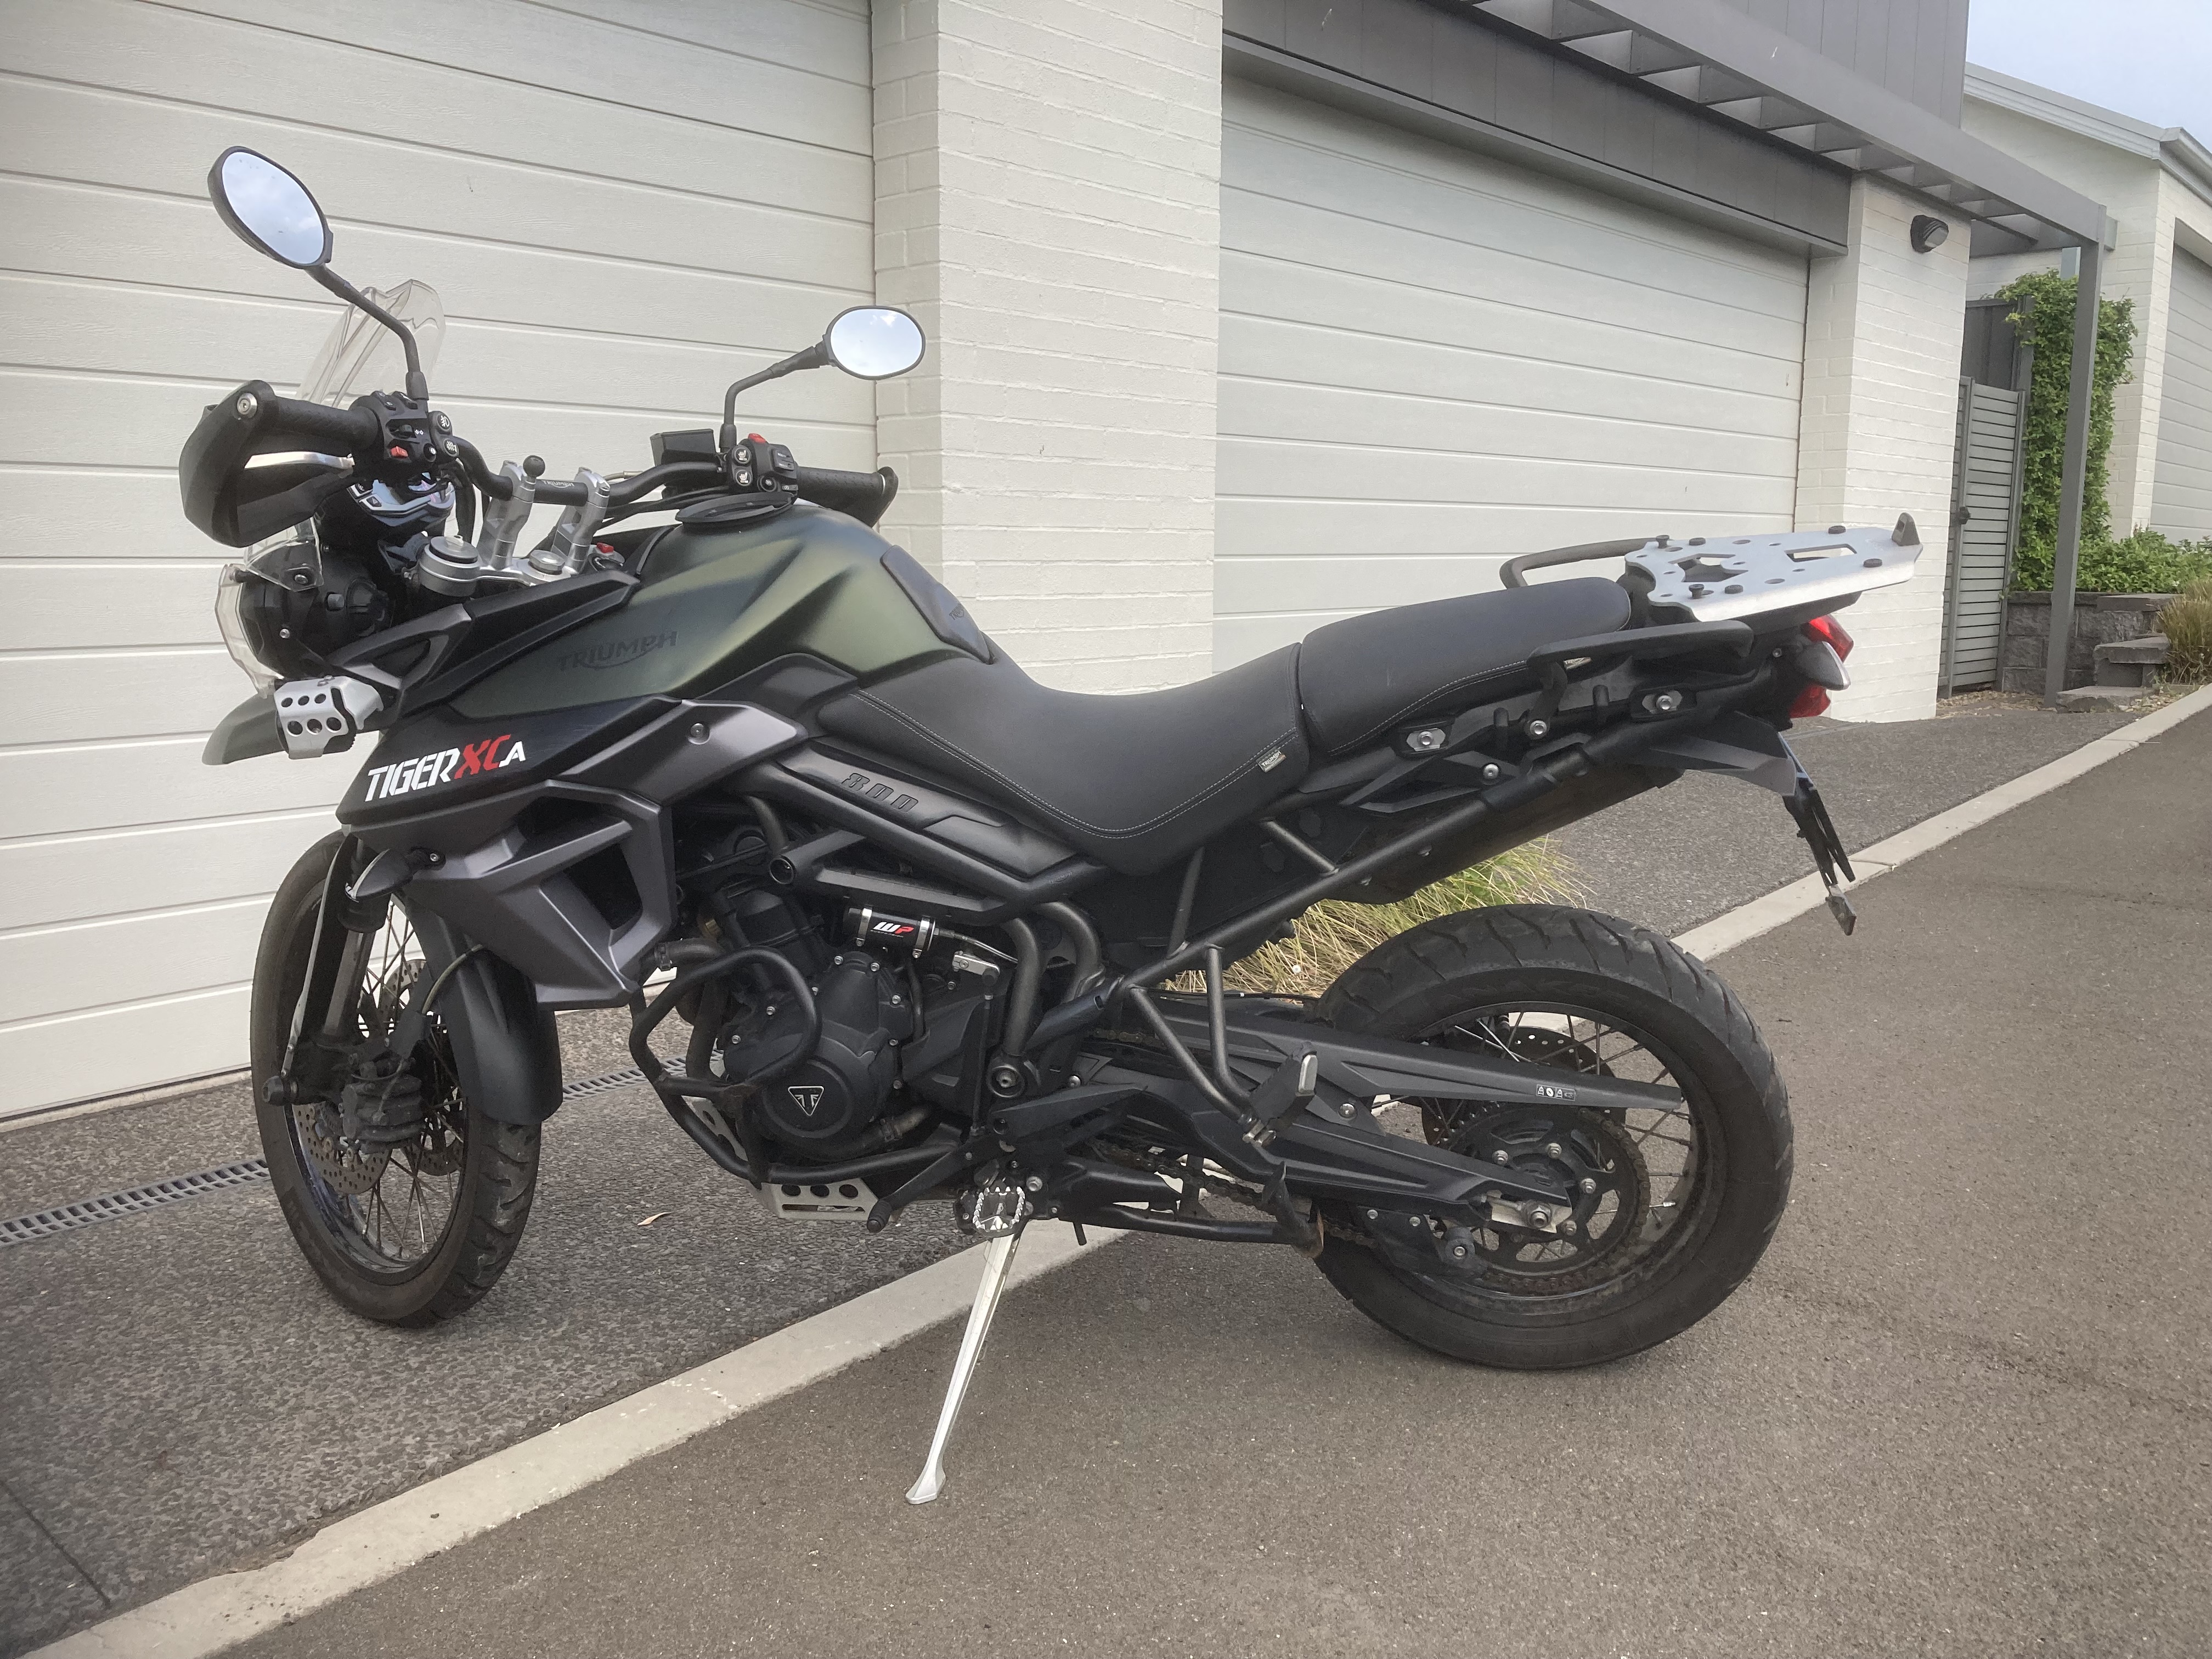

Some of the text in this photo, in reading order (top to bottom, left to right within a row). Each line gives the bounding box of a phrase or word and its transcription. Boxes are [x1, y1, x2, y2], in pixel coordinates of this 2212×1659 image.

[558, 631, 678, 670] TRIUMPH
[1261, 751, 1281, 766] TRIUMPH
[841, 773, 918, 814] 800
[873, 922, 915, 934] WP
